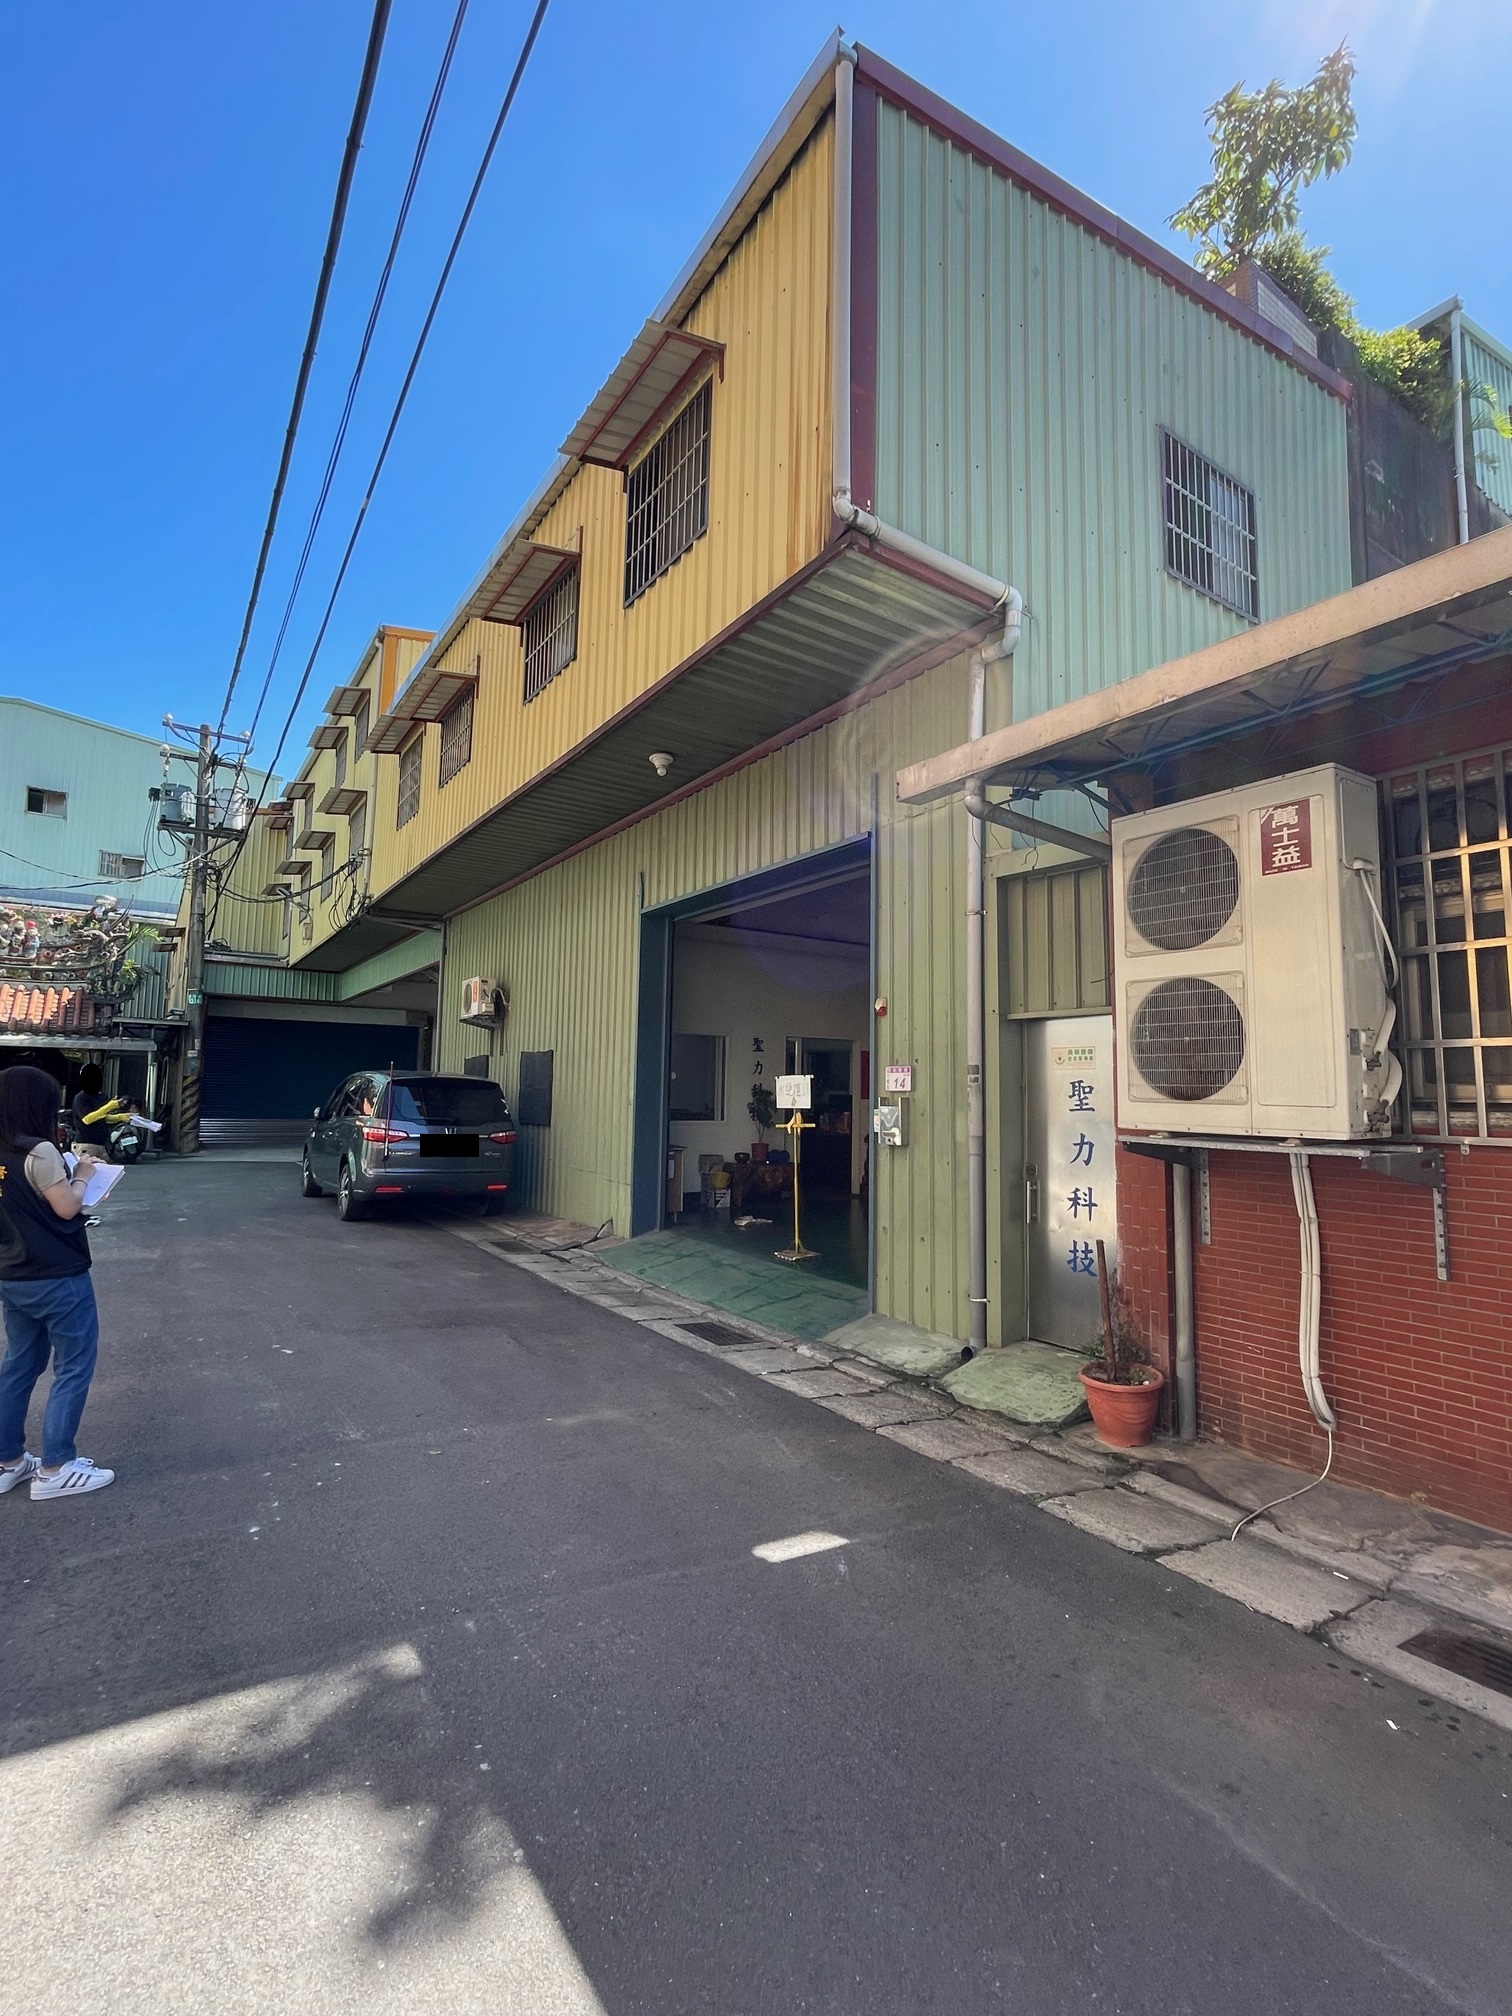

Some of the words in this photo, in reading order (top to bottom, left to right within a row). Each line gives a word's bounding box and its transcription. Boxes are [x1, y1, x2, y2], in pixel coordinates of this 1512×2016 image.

[1271, 805, 1301, 867] 萬士益
[893, 1077, 906, 1089] 14
[1066, 1079, 1098, 1277] 聖力科技
